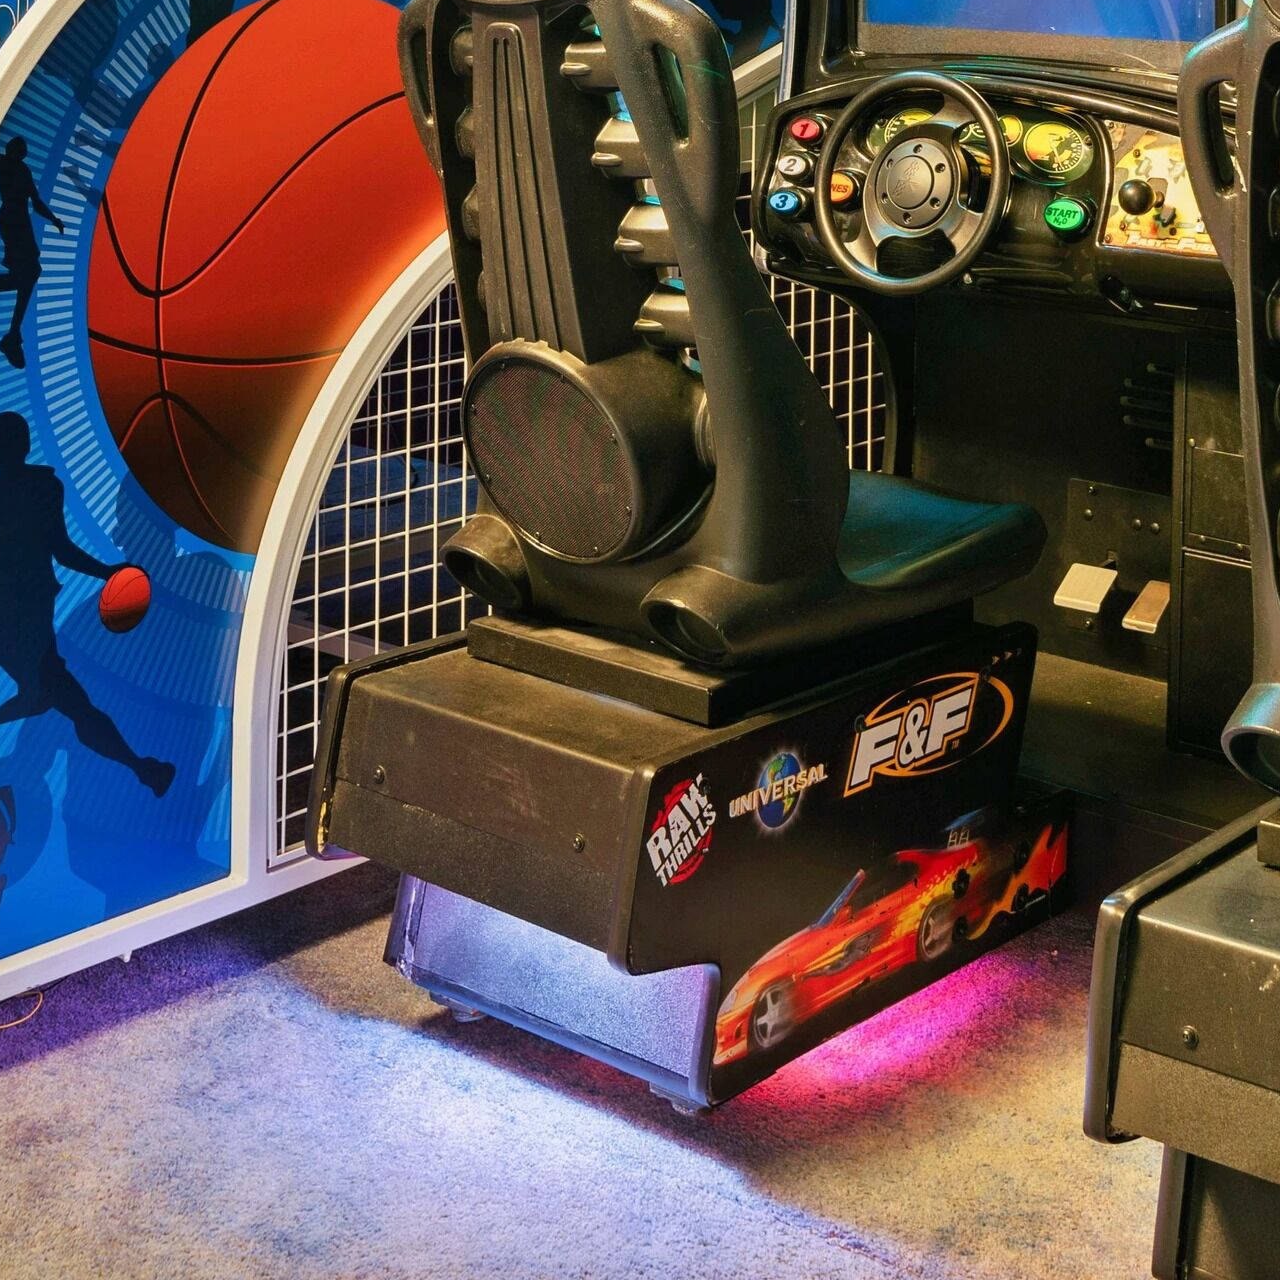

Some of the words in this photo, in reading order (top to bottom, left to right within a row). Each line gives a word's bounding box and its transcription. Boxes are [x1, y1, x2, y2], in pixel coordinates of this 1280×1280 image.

[799, 122, 810, 137] 1
[783, 158, 798, 172] 2
[775, 194, 788, 209] 3
[1046, 206, 1079, 218] START
[849, 686, 975, 788] F&F
[729, 763, 829, 819] UNIVERSAL
[646, 772, 708, 872] RAW
[656, 803, 717, 887] THRILLS
